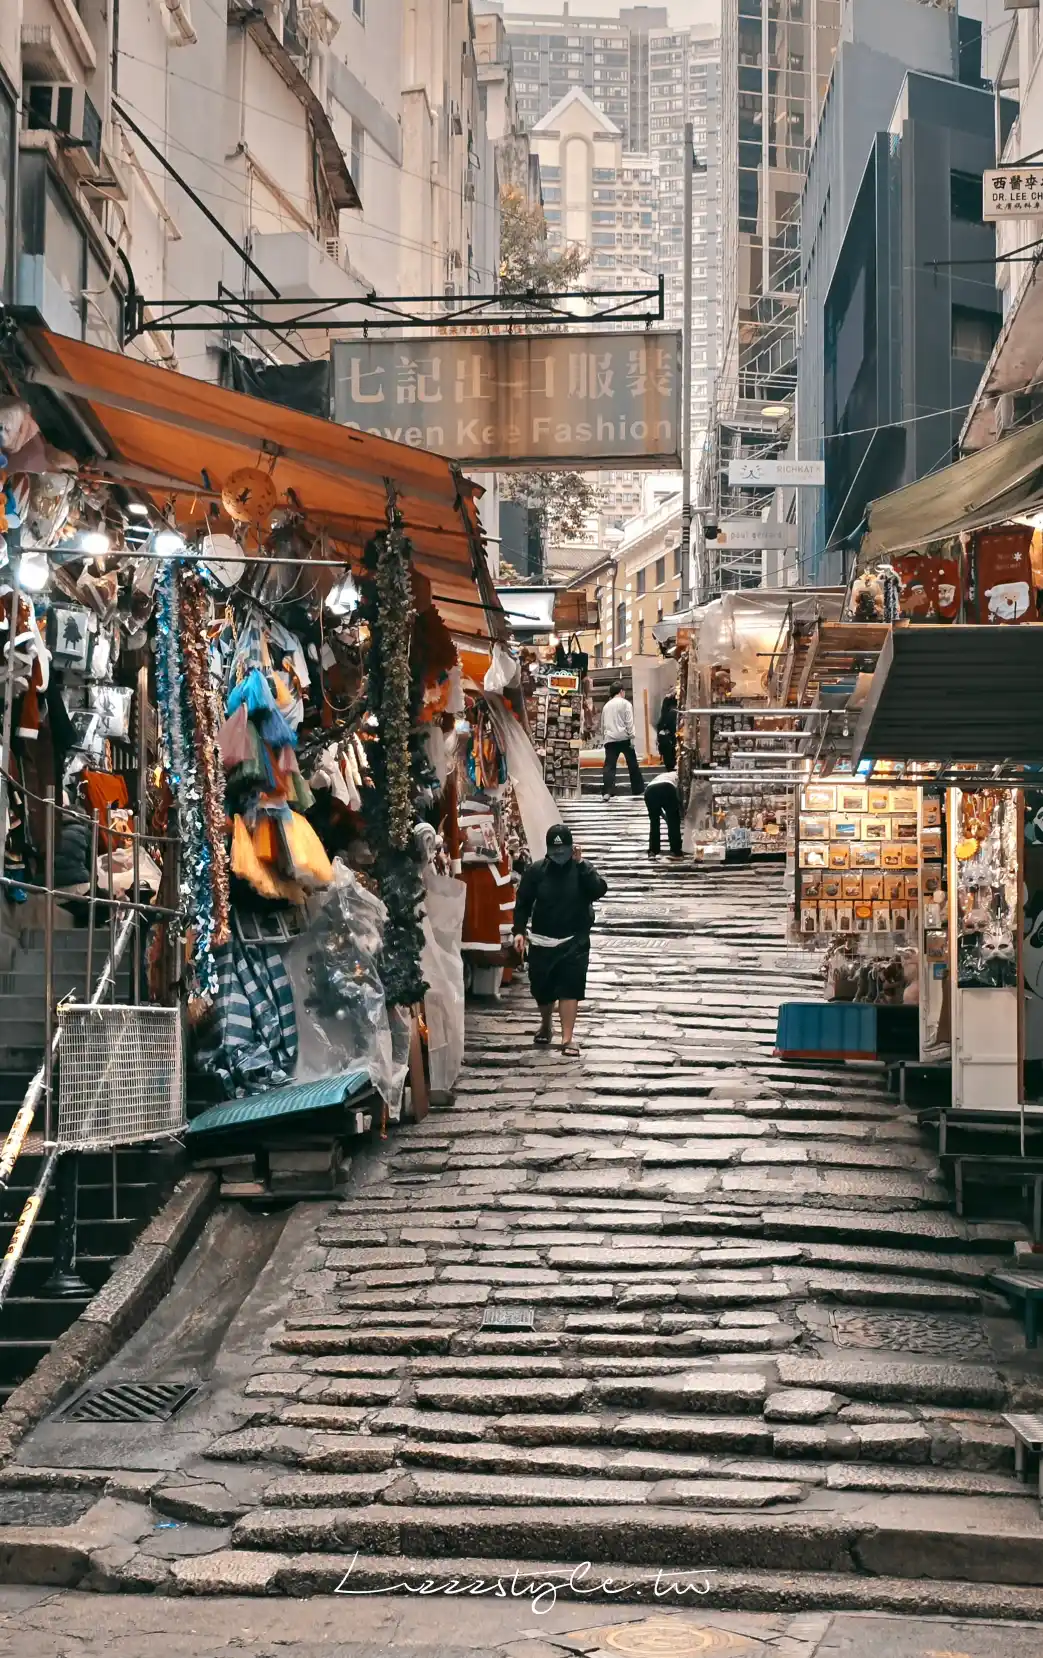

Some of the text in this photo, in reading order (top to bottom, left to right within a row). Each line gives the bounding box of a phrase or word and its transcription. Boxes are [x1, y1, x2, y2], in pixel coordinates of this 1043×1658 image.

[992, 174, 1043, 190] 西醫李
[992, 193, 1007, 202] DR.
[1010, 193, 1027, 201] LEE
[457, 419, 521, 446] Kee
[532, 414, 672, 444] Fashion
